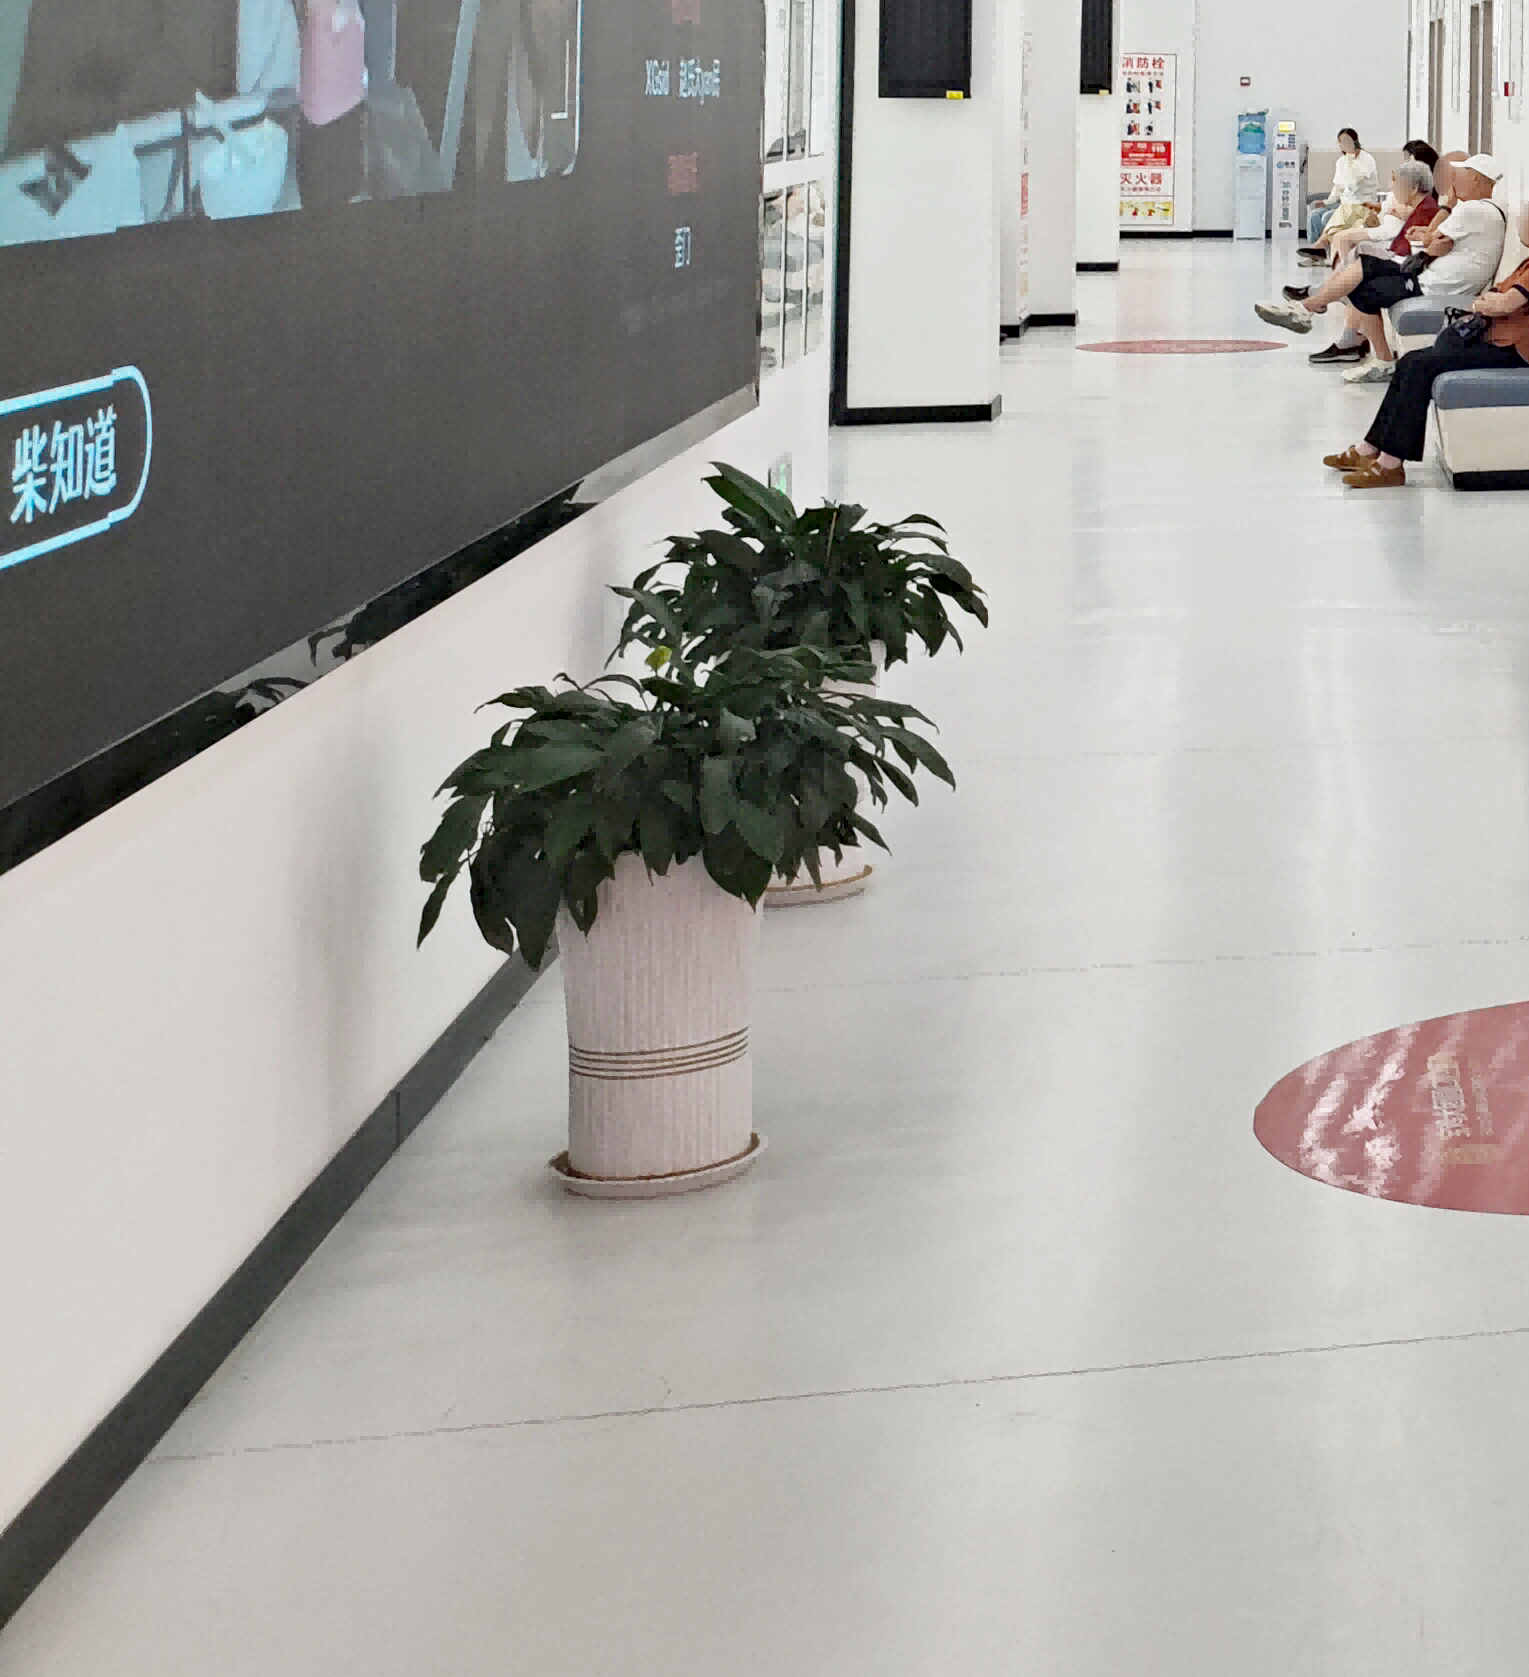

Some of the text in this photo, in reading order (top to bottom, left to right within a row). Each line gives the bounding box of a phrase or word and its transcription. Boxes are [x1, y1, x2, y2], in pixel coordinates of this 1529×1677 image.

[1120, 172, 1162, 185] 灭火器
[10, 404, 117, 524] 柴知道
